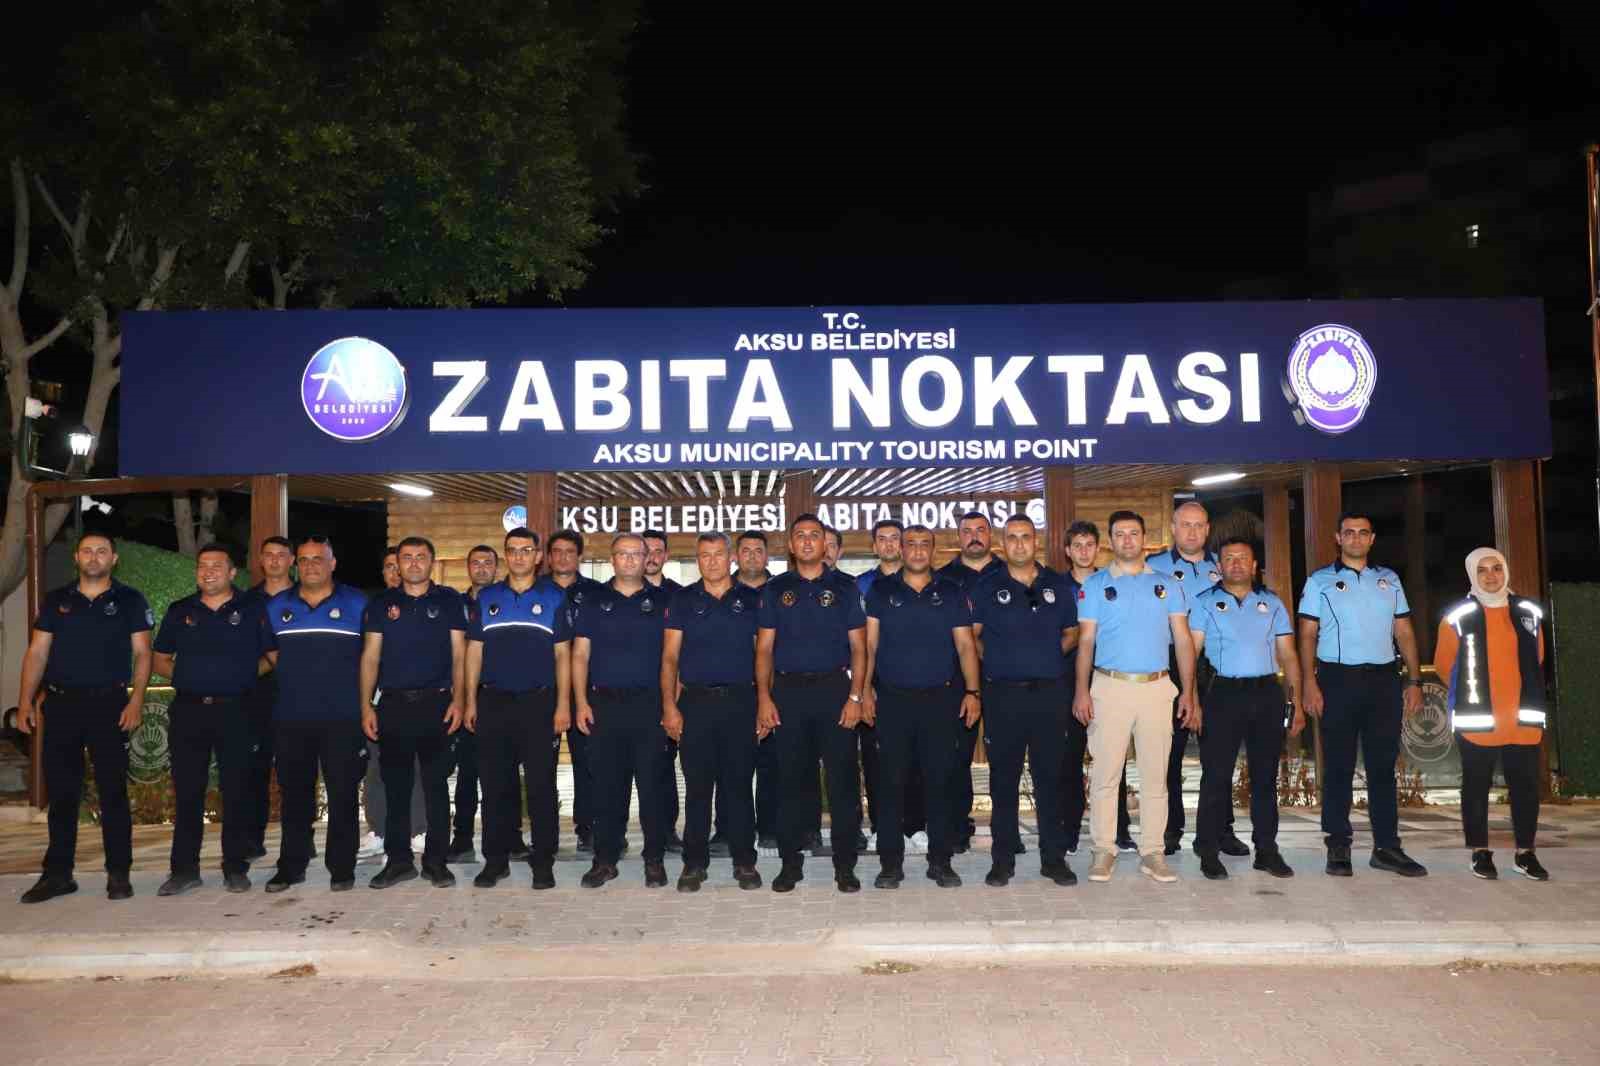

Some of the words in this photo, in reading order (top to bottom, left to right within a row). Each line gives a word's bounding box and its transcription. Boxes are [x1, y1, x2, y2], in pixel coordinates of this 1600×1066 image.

[822, 312, 866, 330] T.C.
[734, 333, 803, 351] AKSU
[811, 328, 956, 351] BELEDİYESİ
[429, 358, 794, 432] ZABITA
[832, 350, 1262, 429] NOKTASI
[593, 443, 672, 463] AKSU
[680, 441, 874, 463] MUNICIPALITY
[880, 440, 1006, 461] TOURISM
[1014, 438, 1098, 459] POINT
[562, 506, 618, 533] KSU
[630, 498, 786, 533] BELEDİYESİ
[816, 502, 893, 531] ABITA
